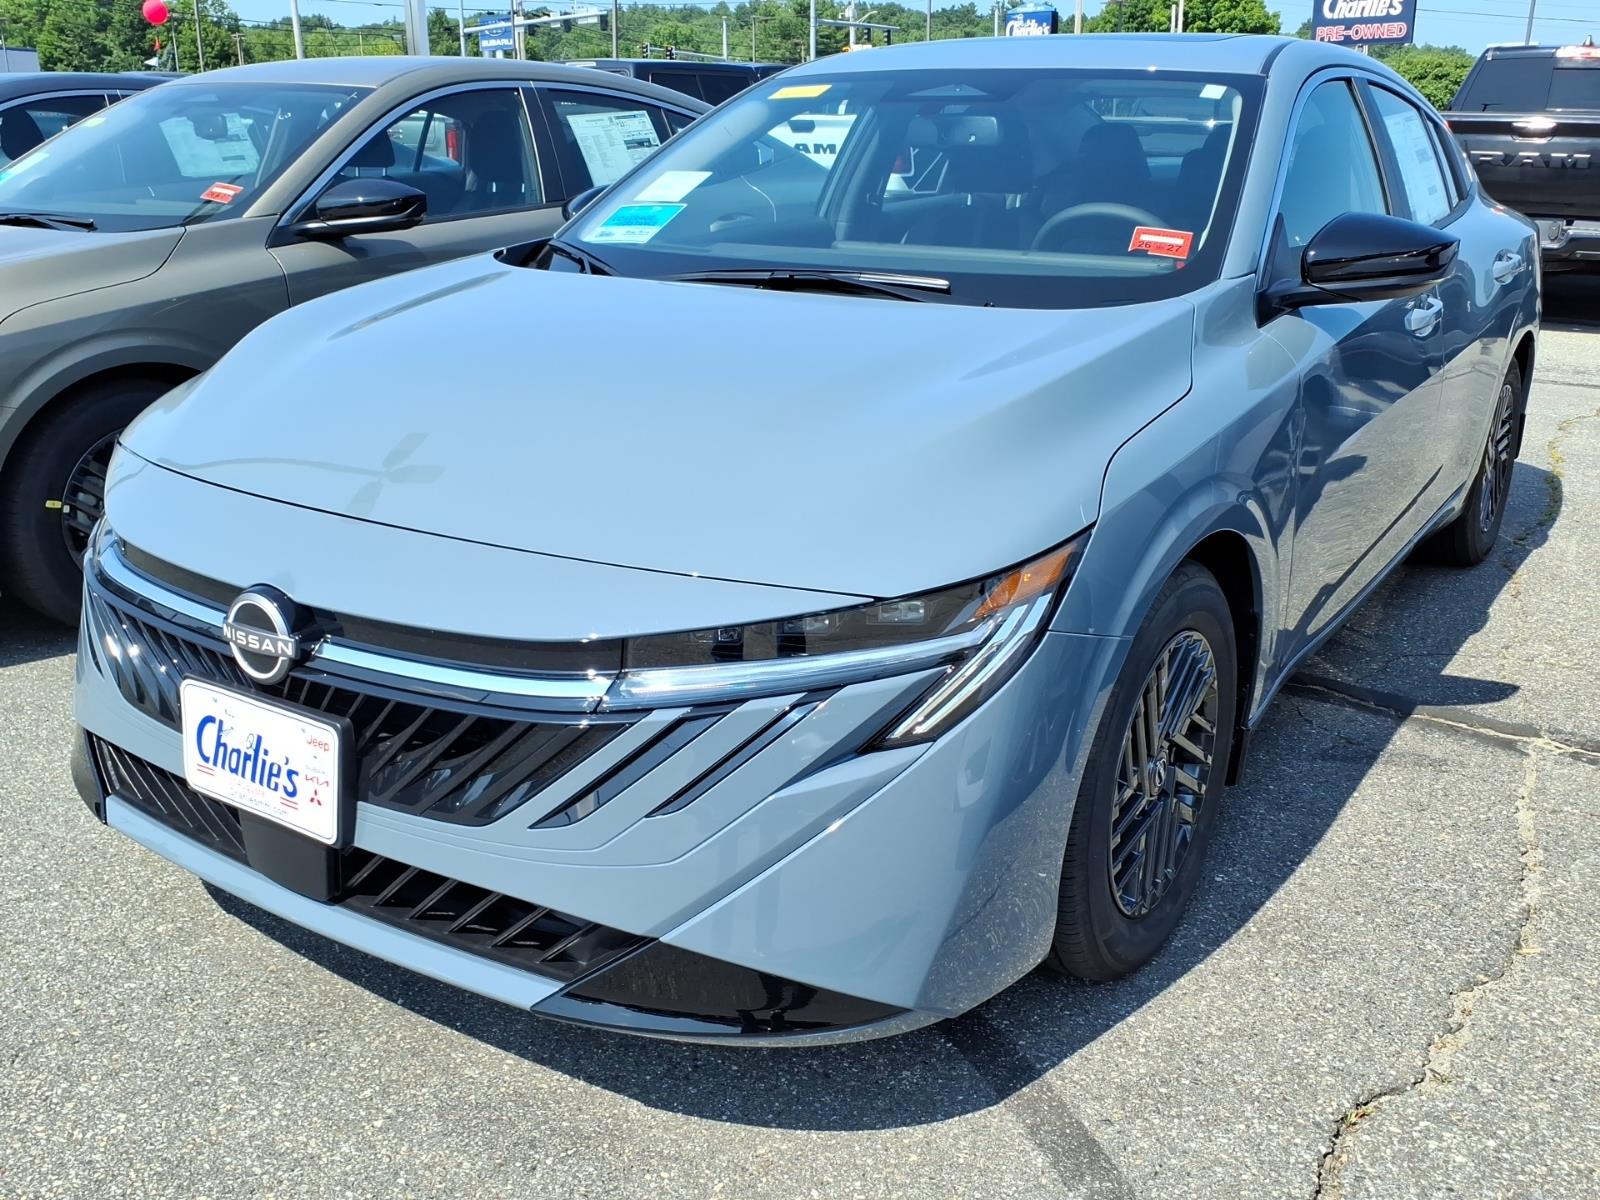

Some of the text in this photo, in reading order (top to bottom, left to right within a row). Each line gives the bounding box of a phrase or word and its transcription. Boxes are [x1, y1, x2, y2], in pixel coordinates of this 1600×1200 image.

[1322, 0, 1403, 19] Charlies
[1316, 22, 1407, 41] PRE-OWNED
[481, 38, 512, 47] SUBARU
[794, 143, 837, 155] AM
[1469, 150, 1591, 169] RAM
[1137, 240, 1151, 249] 26
[1166, 244, 1182, 252] 27
[223, 623, 293, 656] NISSAN
[306, 735, 330, 752] Jeep
[196, 715, 299, 798] Charlie's
